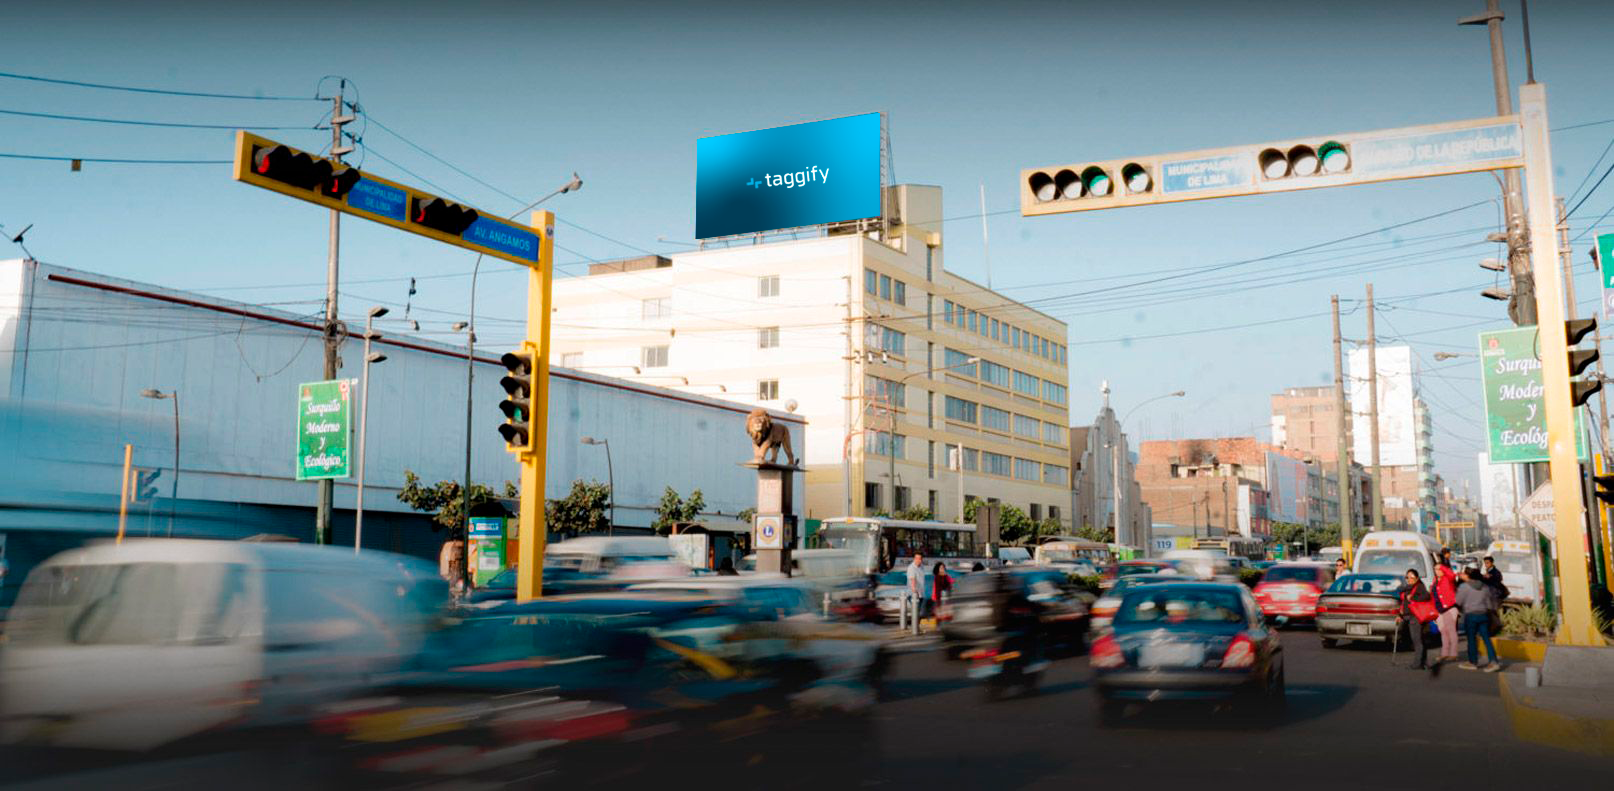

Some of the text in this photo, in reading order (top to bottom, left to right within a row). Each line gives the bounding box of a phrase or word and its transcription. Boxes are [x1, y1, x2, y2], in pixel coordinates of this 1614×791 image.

[1416, 144, 1433, 161] DE
[1168, 158, 1243, 176] MUNICIPAL
[764, 165, 830, 189] taggify
[1187, 173, 1228, 188] DE LIMA
[474, 226, 530, 252] AV. ANGAMOS
[306, 399, 340, 417] Surquillo
[1526, 403, 1537, 421] y
[306, 419, 340, 435] Moderno
[318, 436, 326, 450] y
[304, 452, 341, 471] Ecológico
[1157, 540, 1172, 549] 119
